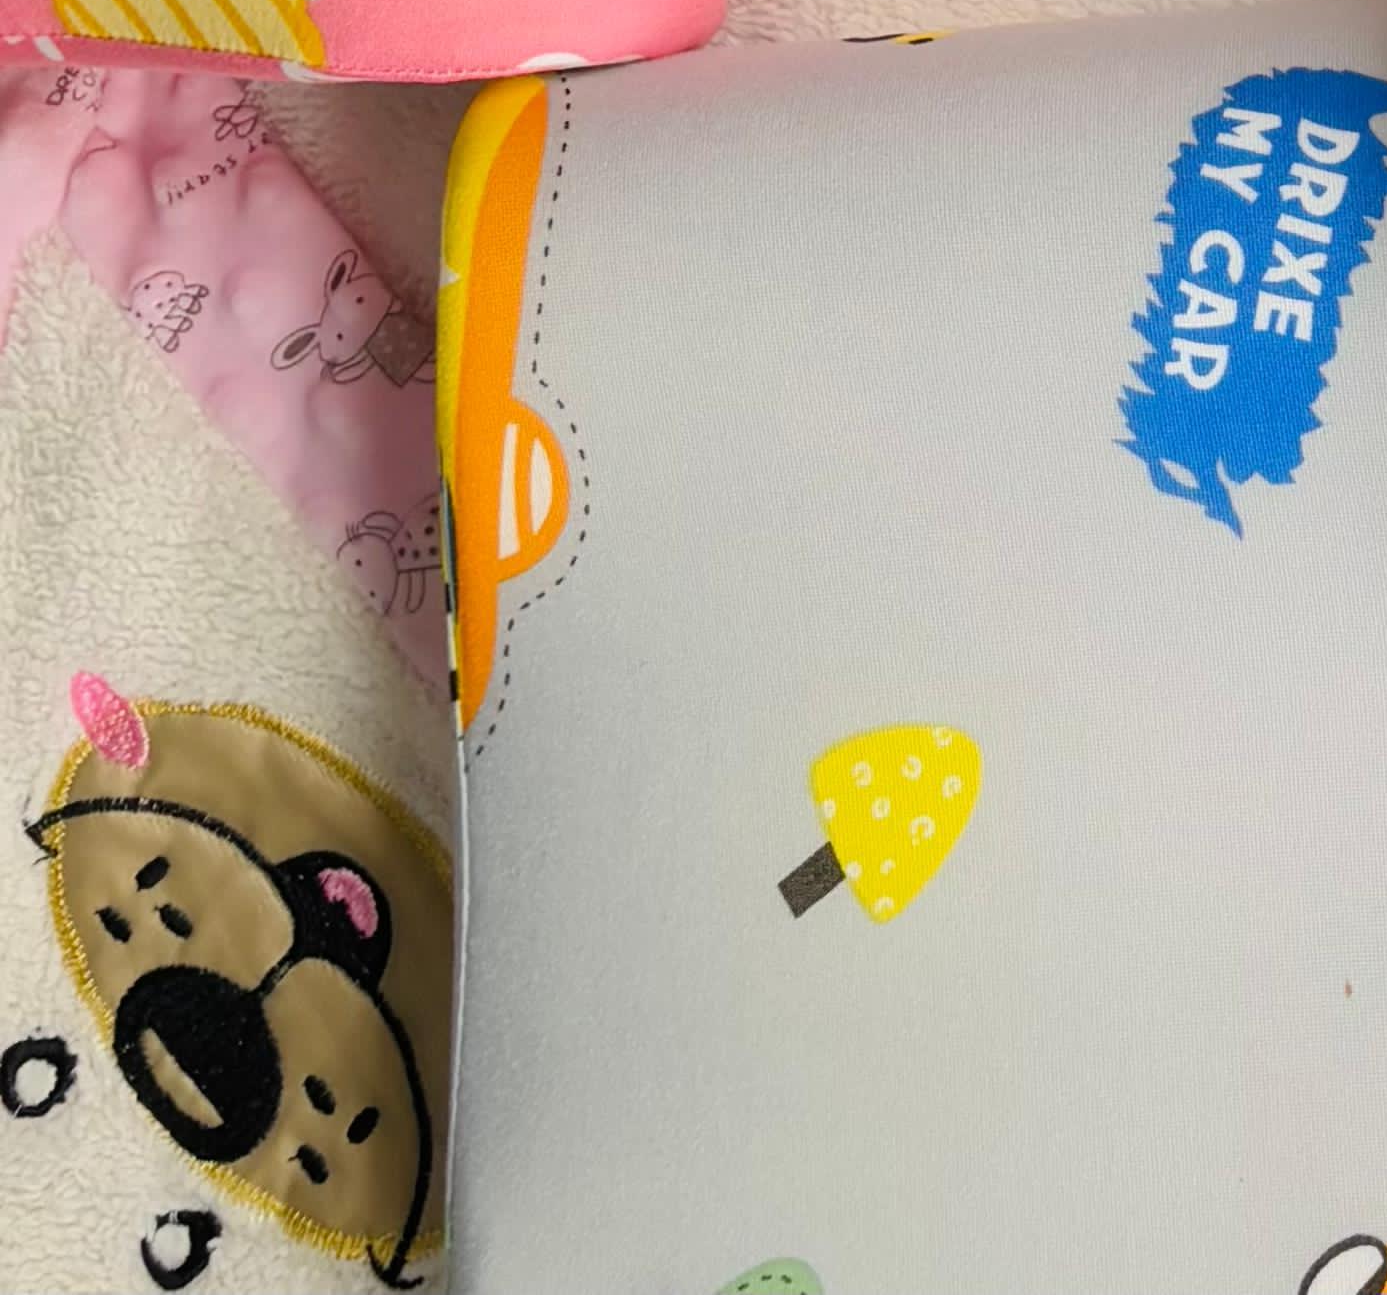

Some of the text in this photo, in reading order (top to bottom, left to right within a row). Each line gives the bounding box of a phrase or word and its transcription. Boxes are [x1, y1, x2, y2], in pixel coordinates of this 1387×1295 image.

[1164, 107, 1283, 391] MY CAR
[1254, 117, 1360, 342] DRIXE
